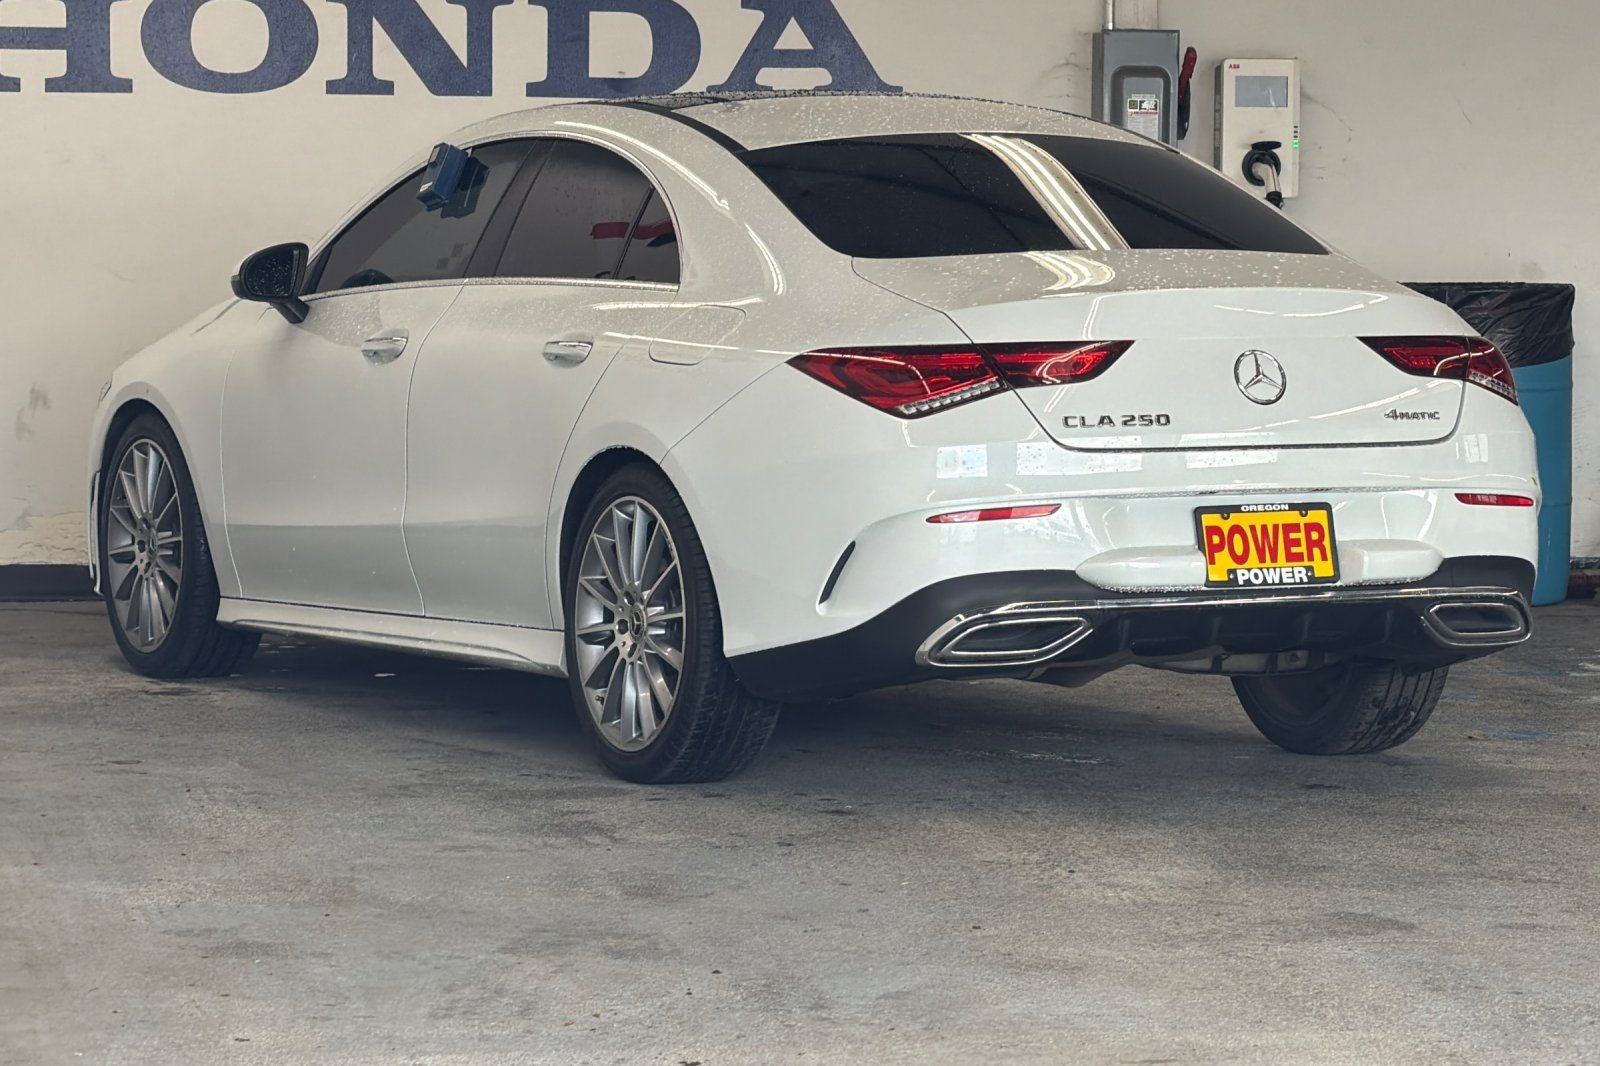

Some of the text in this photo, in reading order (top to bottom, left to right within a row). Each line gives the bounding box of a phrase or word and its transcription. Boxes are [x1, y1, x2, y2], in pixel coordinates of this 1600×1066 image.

[0, 0, 903, 97] HONDA
[1062, 414, 1171, 428] CLA 250
[1383, 408, 1441, 421] 4MATIC
[1240, 503, 1290, 512] OREGON
[1205, 522, 1328, 565] POWER
[1236, 566, 1309, 585] POWER
